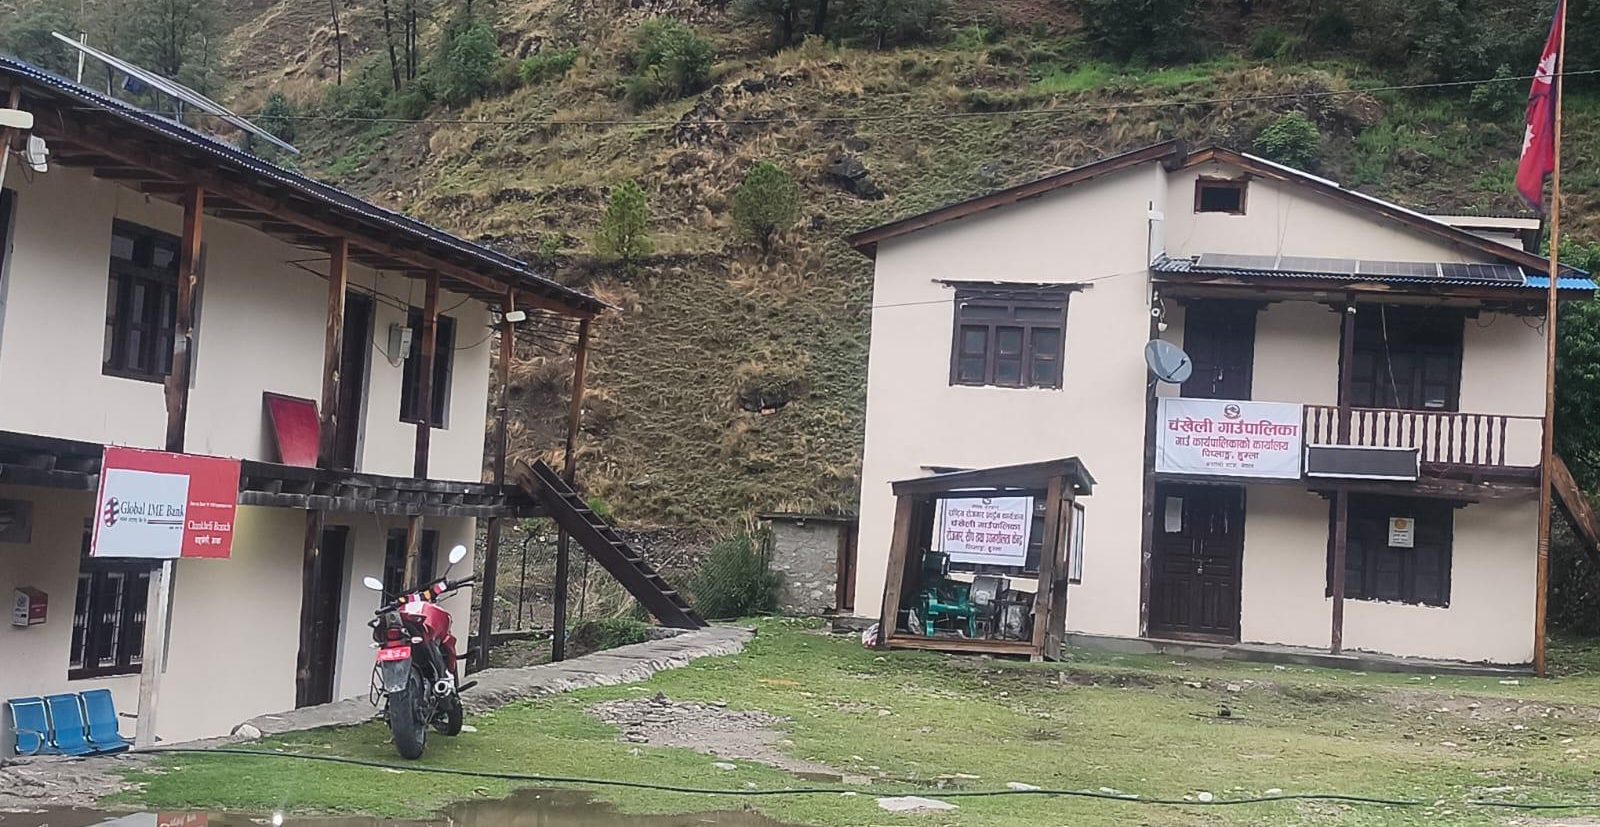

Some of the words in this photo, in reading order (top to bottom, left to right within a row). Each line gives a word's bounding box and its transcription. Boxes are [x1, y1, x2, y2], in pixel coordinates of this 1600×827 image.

[1253, 438, 1289, 450] कार्यालय
[120, 501, 146, 516] Global
[148, 504, 164, 516] IME
[166, 504, 184, 517] Bank
